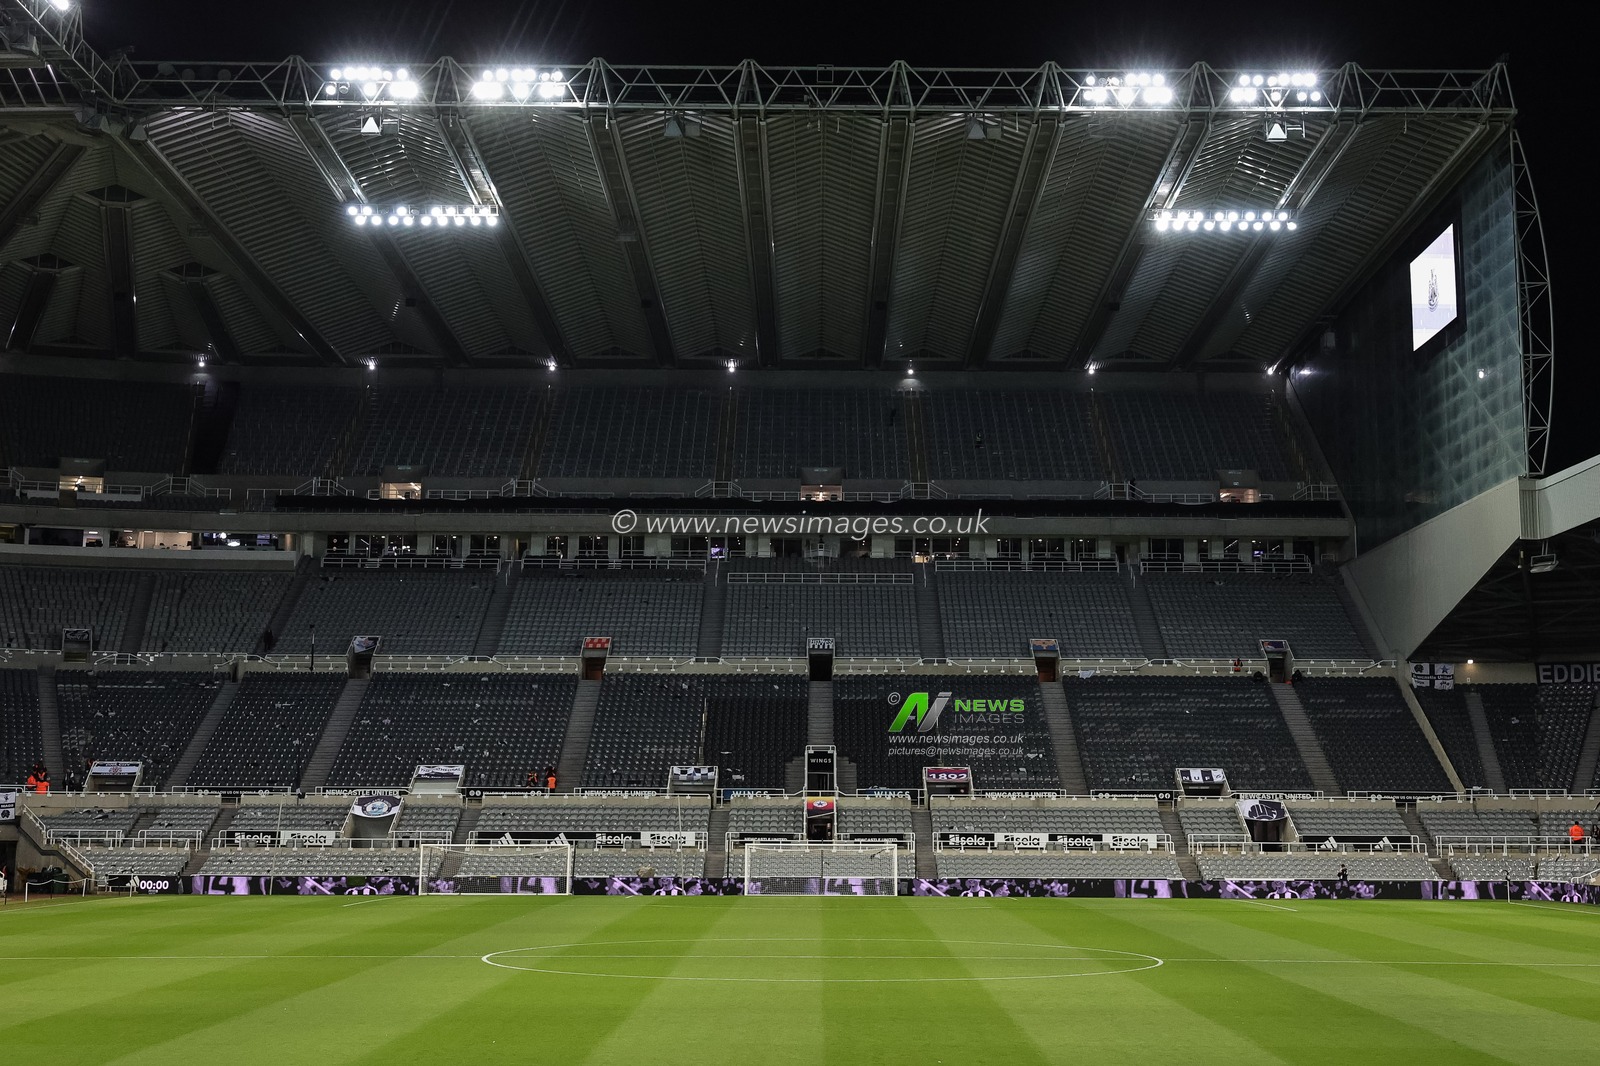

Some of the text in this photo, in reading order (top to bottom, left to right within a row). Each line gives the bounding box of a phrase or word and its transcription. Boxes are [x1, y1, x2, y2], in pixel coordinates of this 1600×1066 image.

[1538, 664, 1600, 683] EDDIE
[325, 788, 400, 796] NEWCASTLE UNITED
[732, 790, 770, 798] WINGS
[874, 790, 910, 798] WINGS
[246, 832, 271, 844] sela
[301, 832, 327, 844] sela
[606, 833, 632, 845] sela
[661, 833, 687, 845] sela
[960, 834, 986, 846] sela
[1015, 835, 1040, 846] sela
[1068, 835, 1094, 847] sela
[1123, 836, 1149, 847] sela
[140, 880, 169, 890] 00:00
